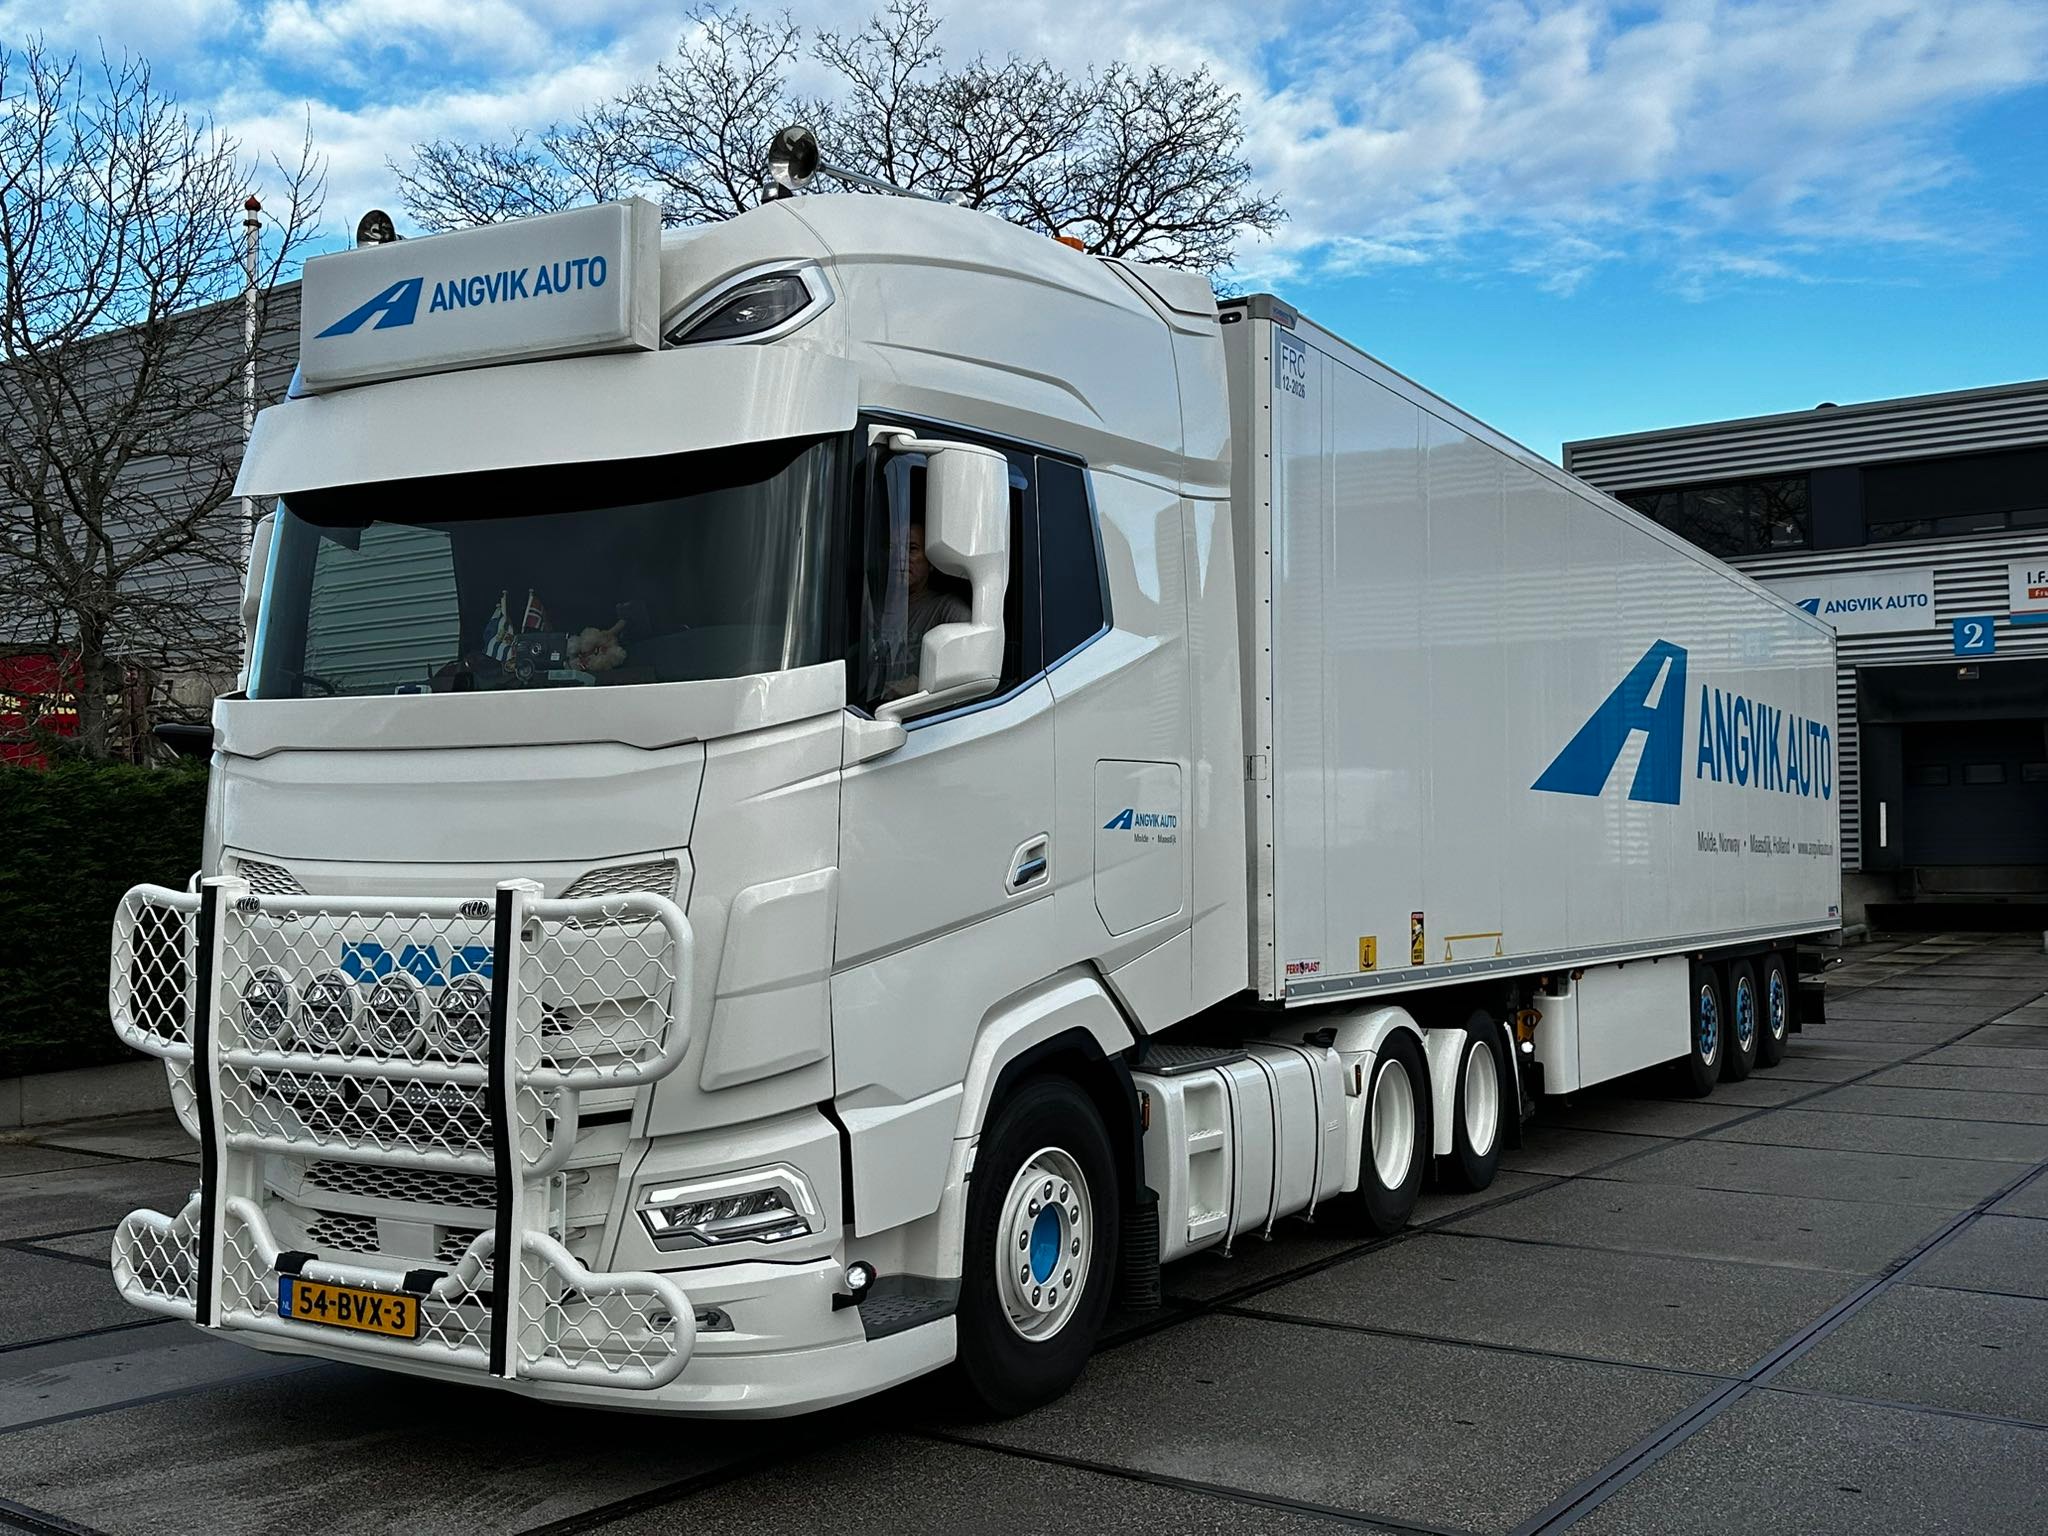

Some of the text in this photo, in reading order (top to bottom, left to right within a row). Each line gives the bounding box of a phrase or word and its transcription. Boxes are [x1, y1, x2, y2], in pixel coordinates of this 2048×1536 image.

[429, 268, 529, 313] ANGVIK
[532, 255, 607, 297] AUTO
[1282, 345, 1306, 379] FRC
[1824, 593, 1928, 614] ANGVIK AUTO
[1963, 623, 1984, 648] 2
[1697, 684, 1784, 793] ANGVIK
[1786, 714, 1832, 800] AUTO
[1134, 813, 1160, 828] ANGVIK
[1160, 814, 1177, 829] AUTO
[281, 1286, 406, 1330] NL 54-BVX-3
